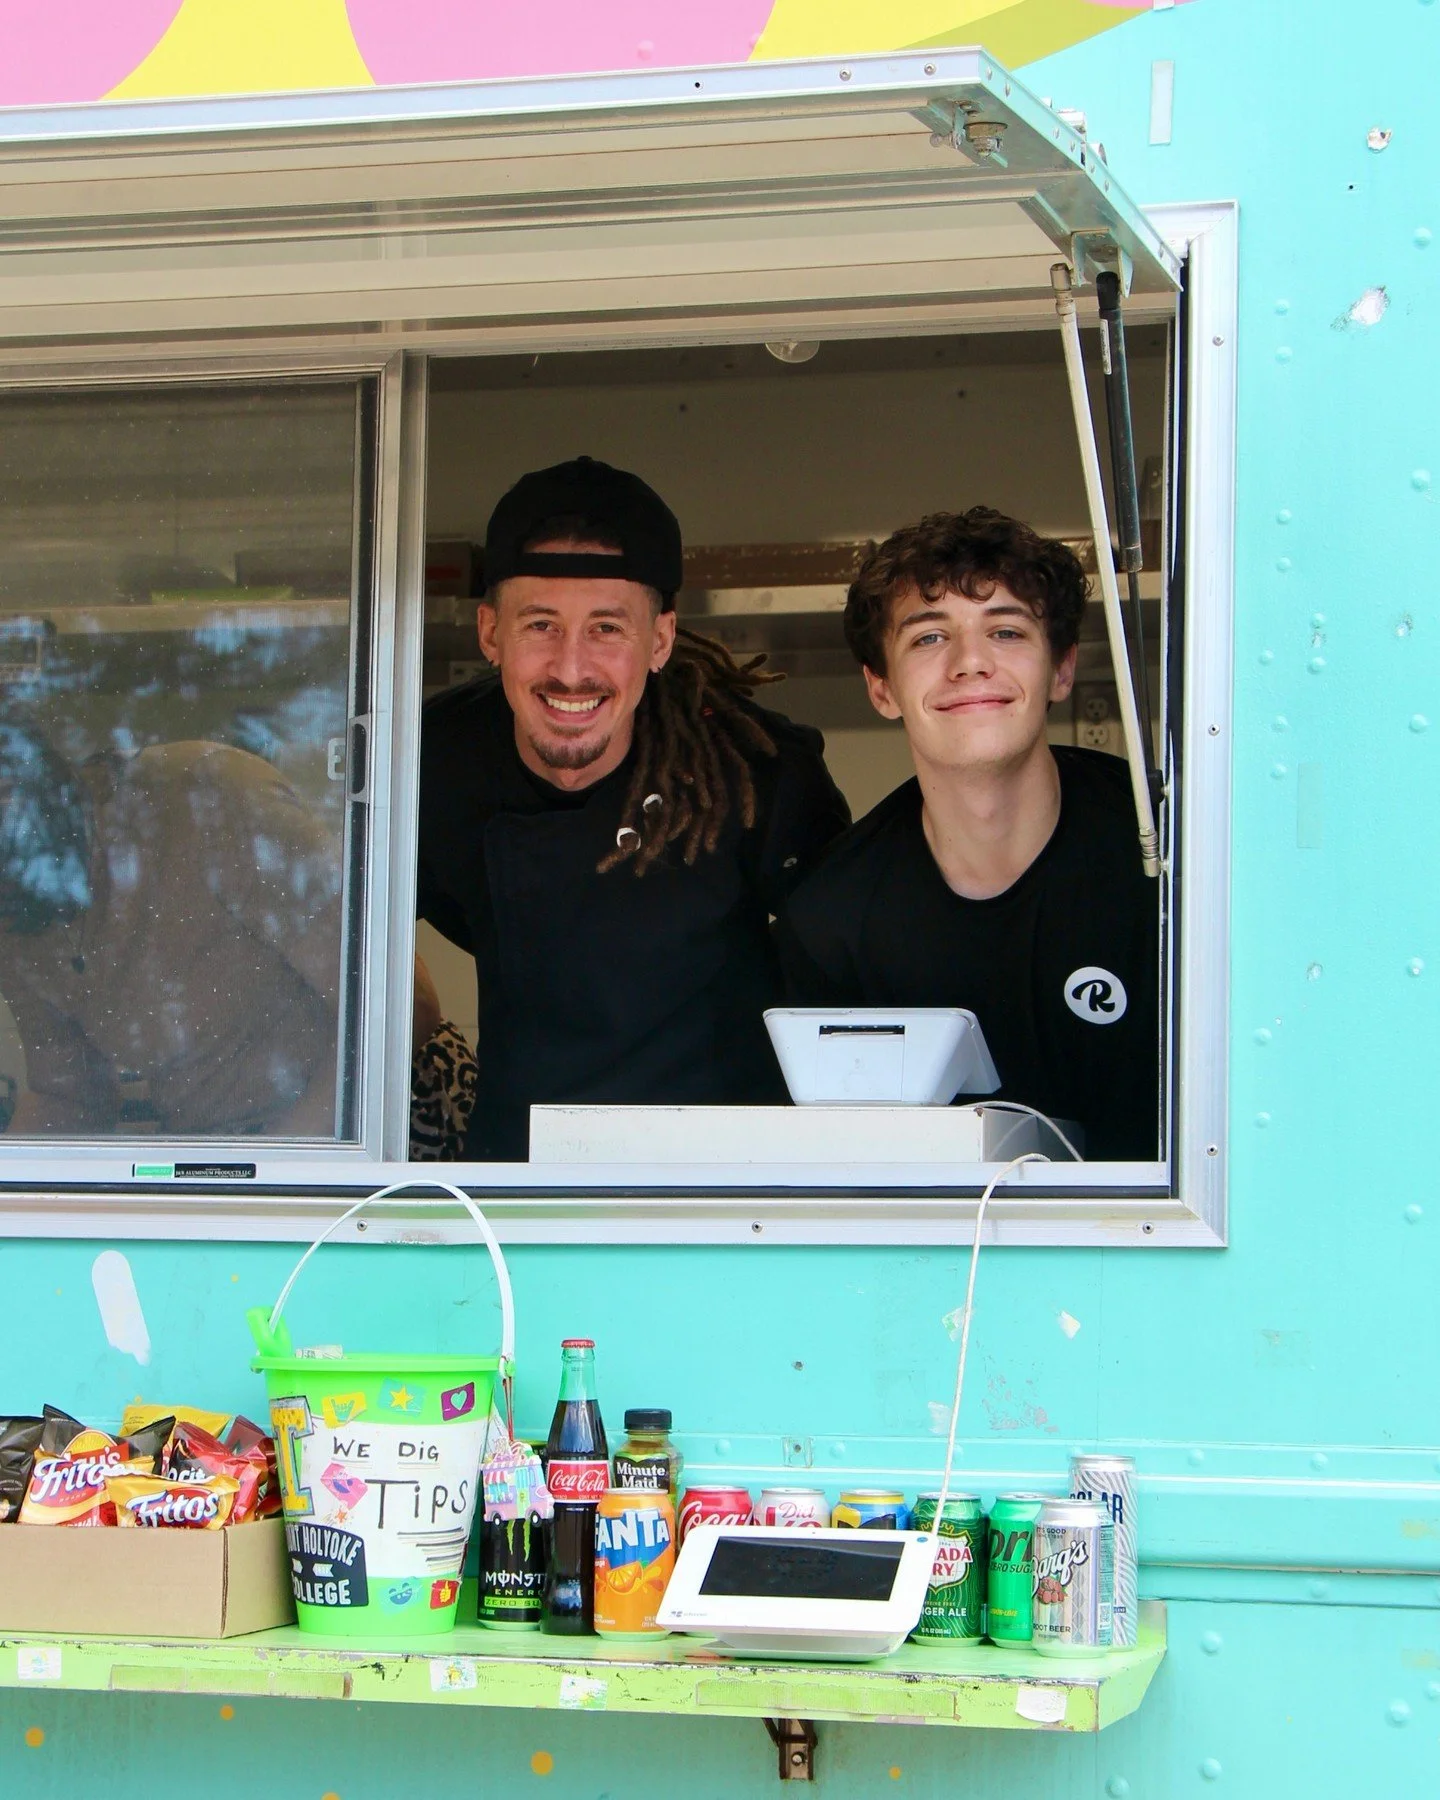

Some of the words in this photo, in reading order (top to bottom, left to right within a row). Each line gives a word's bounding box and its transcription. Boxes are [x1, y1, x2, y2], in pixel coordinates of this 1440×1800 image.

[1071, 979, 1116, 1013] R
[333, 1436, 371, 1458] WE
[398, 1441, 439, 1461] DiG
[30, 1458, 105, 1503] Frito
[616, 1461, 666, 1476] Minute
[622, 1475, 659, 1488] Maid
[125, 1489, 219, 1527] Fritos
[302, 1525, 362, 1567] HOLYOKE
[936, 1547, 972, 1561] ADA
[932, 1562, 955, 1576] RY
[291, 1571, 351, 1605] OLLEGE
[922, 1606, 945, 1616] GER
[948, 1607, 967, 1617] ALE
